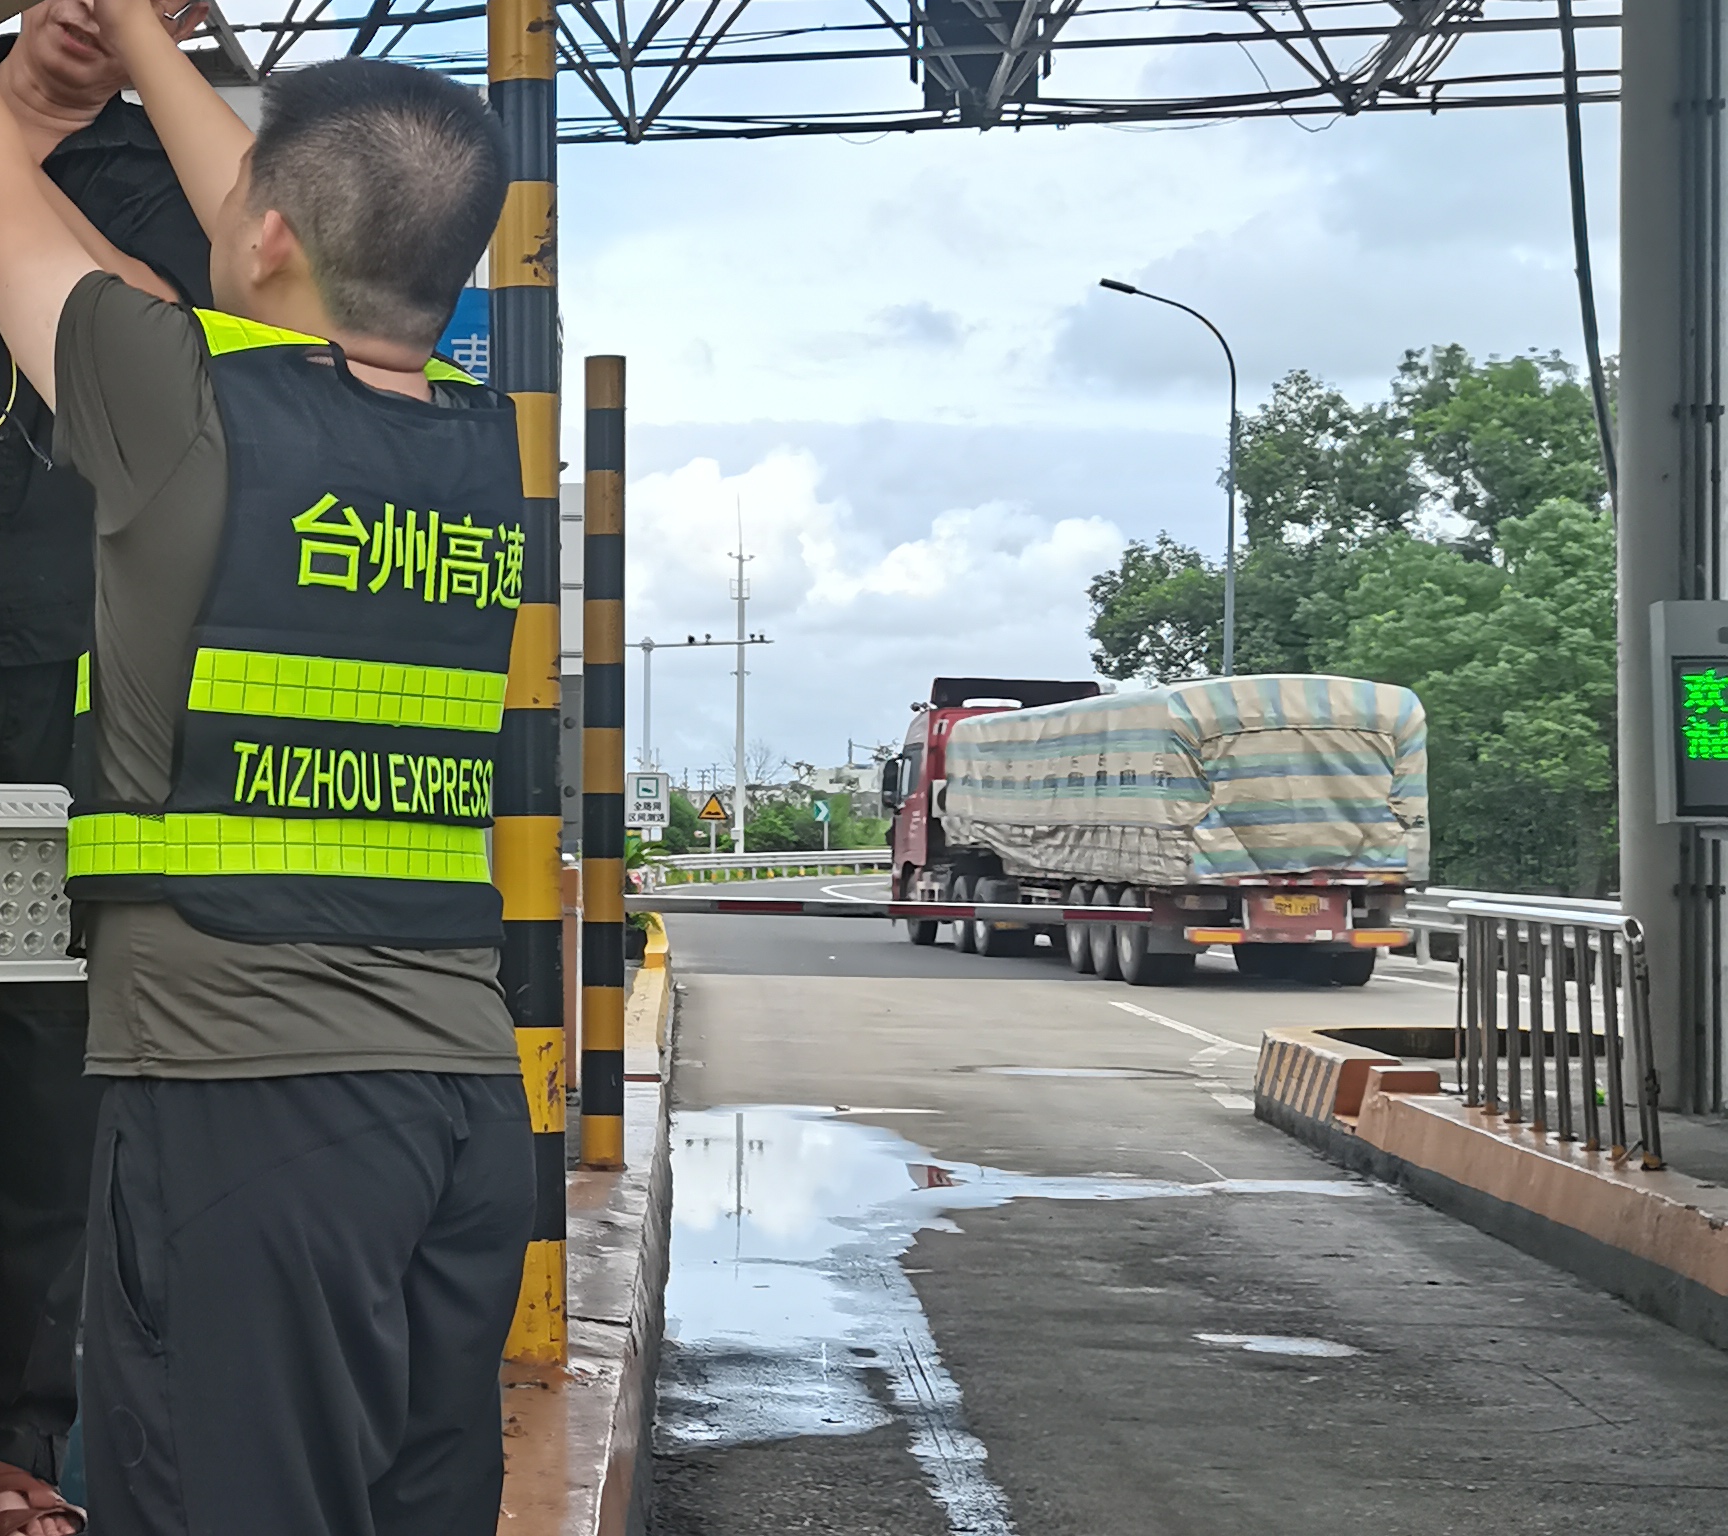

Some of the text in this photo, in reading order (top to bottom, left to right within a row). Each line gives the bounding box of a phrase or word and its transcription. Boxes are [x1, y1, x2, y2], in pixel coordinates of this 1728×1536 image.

[291, 493, 525, 609] 台州高速
[233, 741, 381, 812] TAIZHOU
